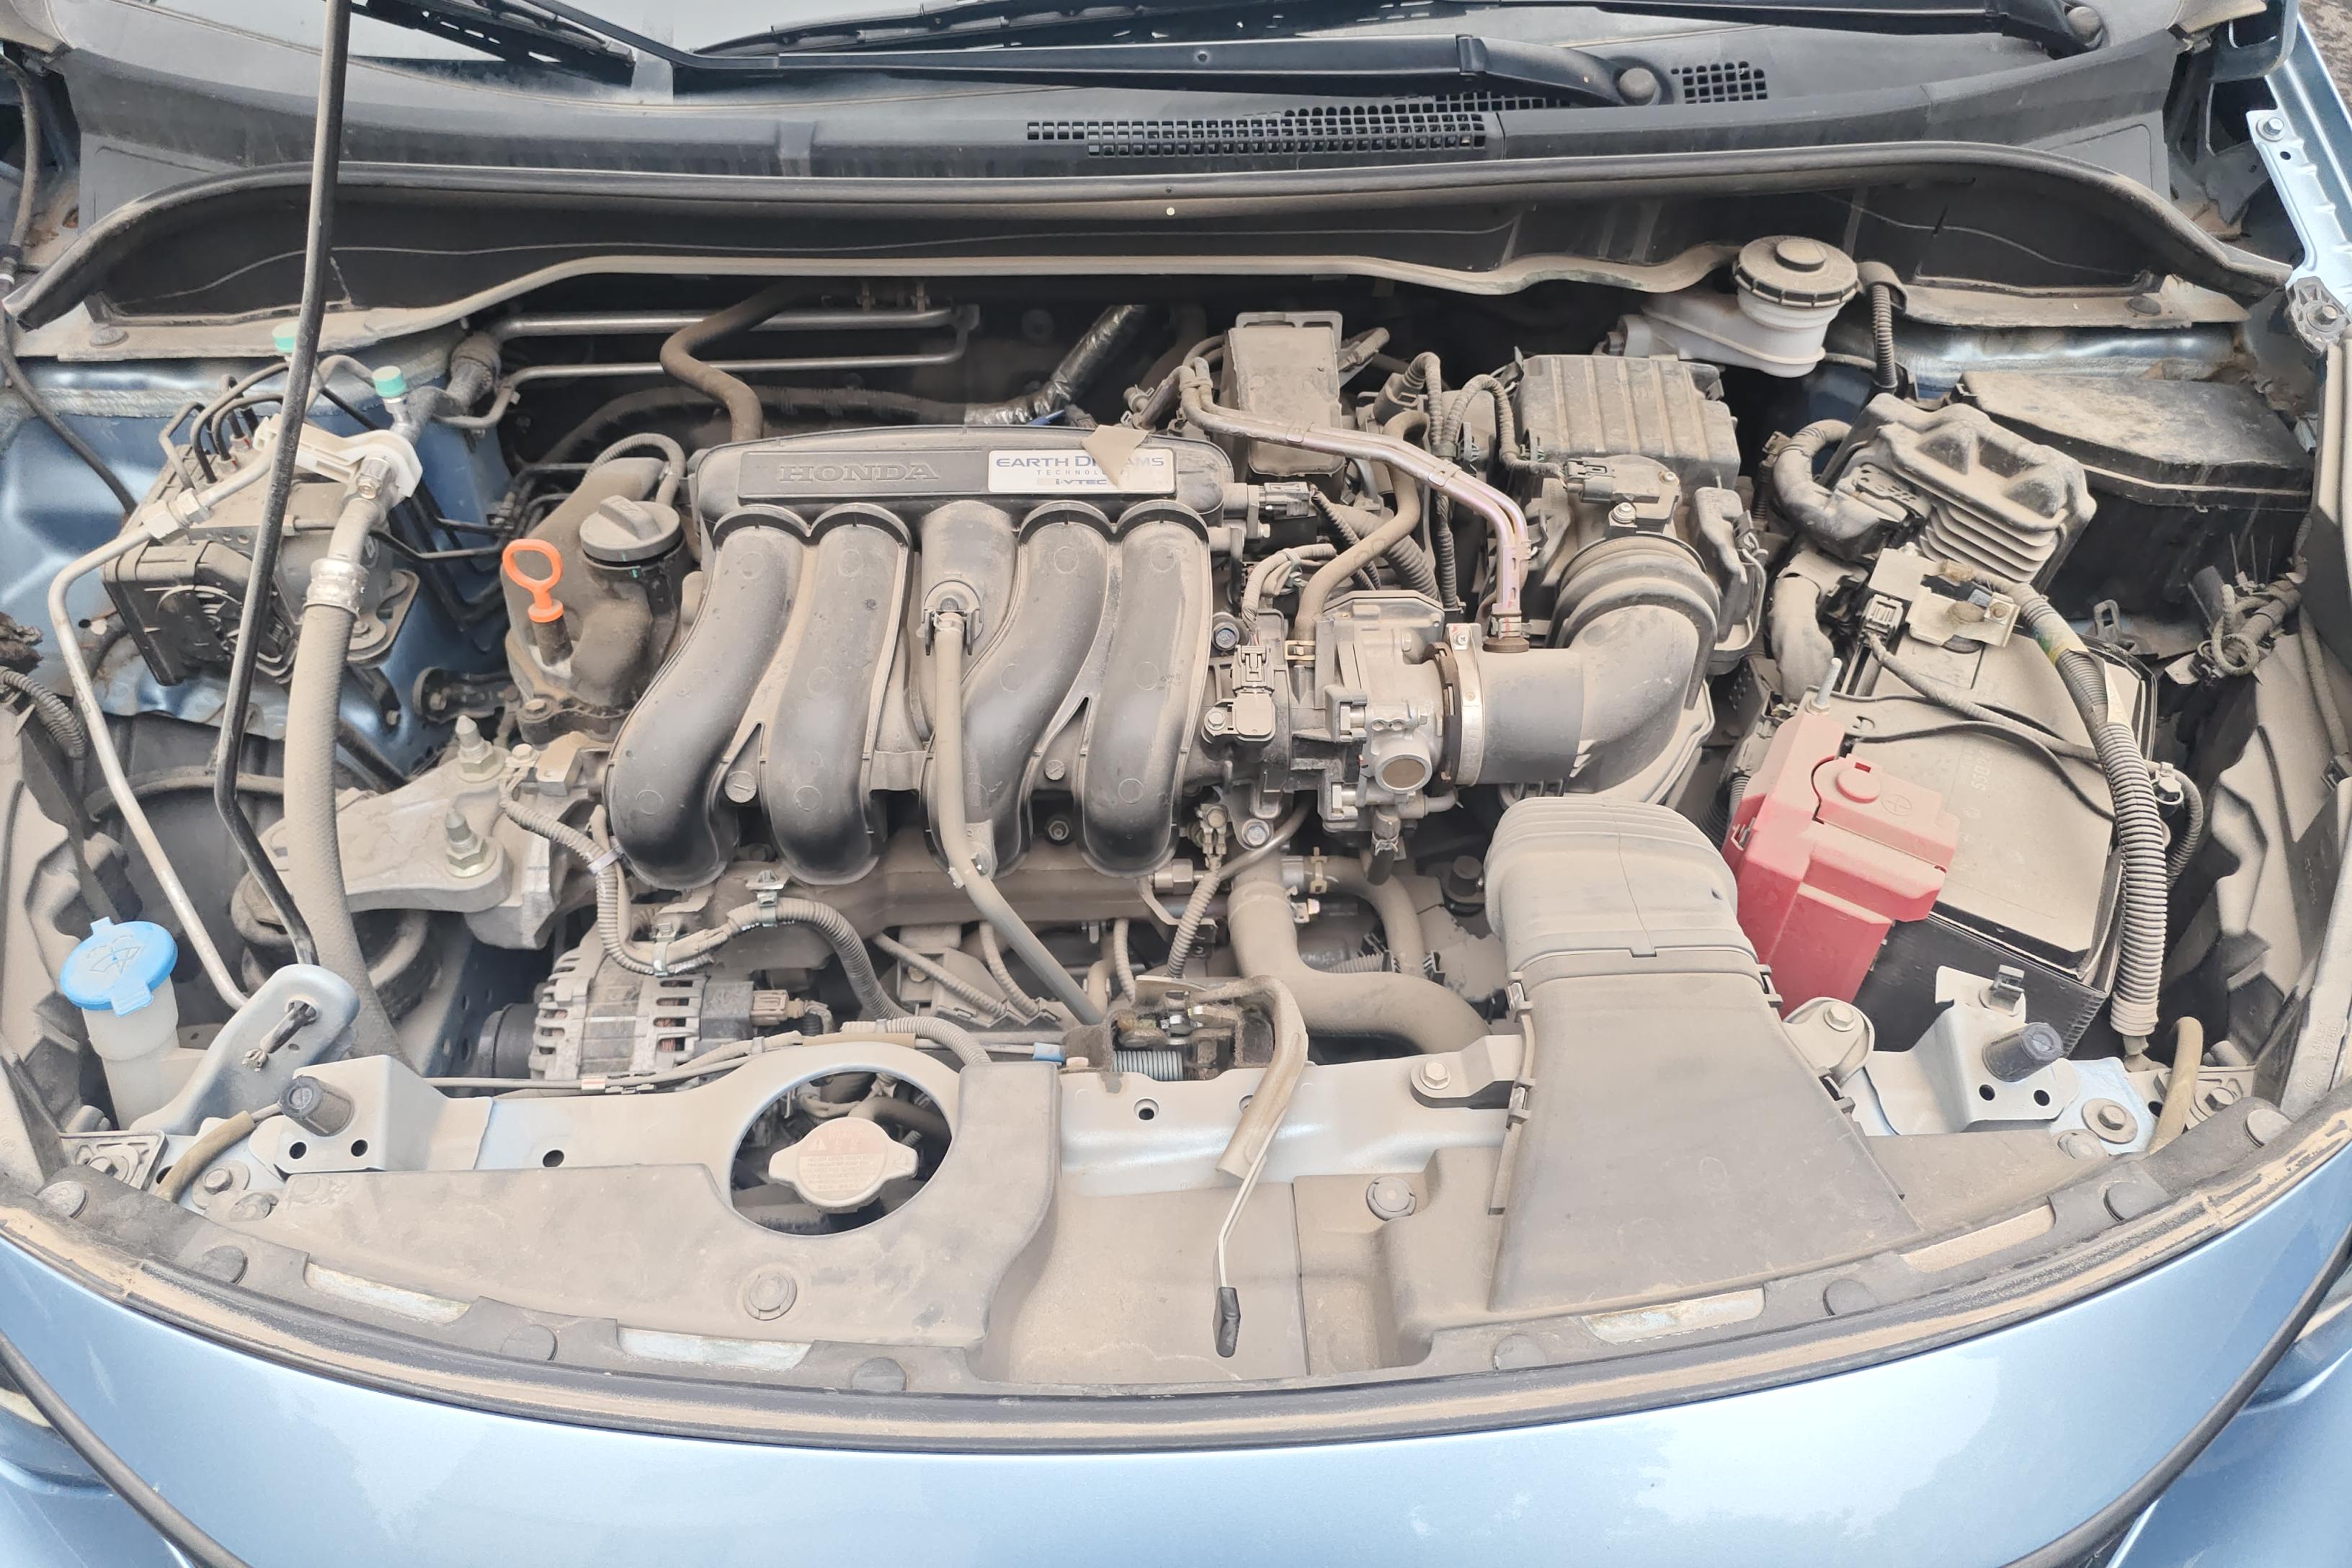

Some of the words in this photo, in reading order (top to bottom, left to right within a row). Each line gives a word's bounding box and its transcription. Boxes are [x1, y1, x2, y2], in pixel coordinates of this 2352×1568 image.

[995, 457, 1069, 467] EARTH
[1074, 455, 1164, 467] DAMS
[779, 463, 940, 482] HONDA
